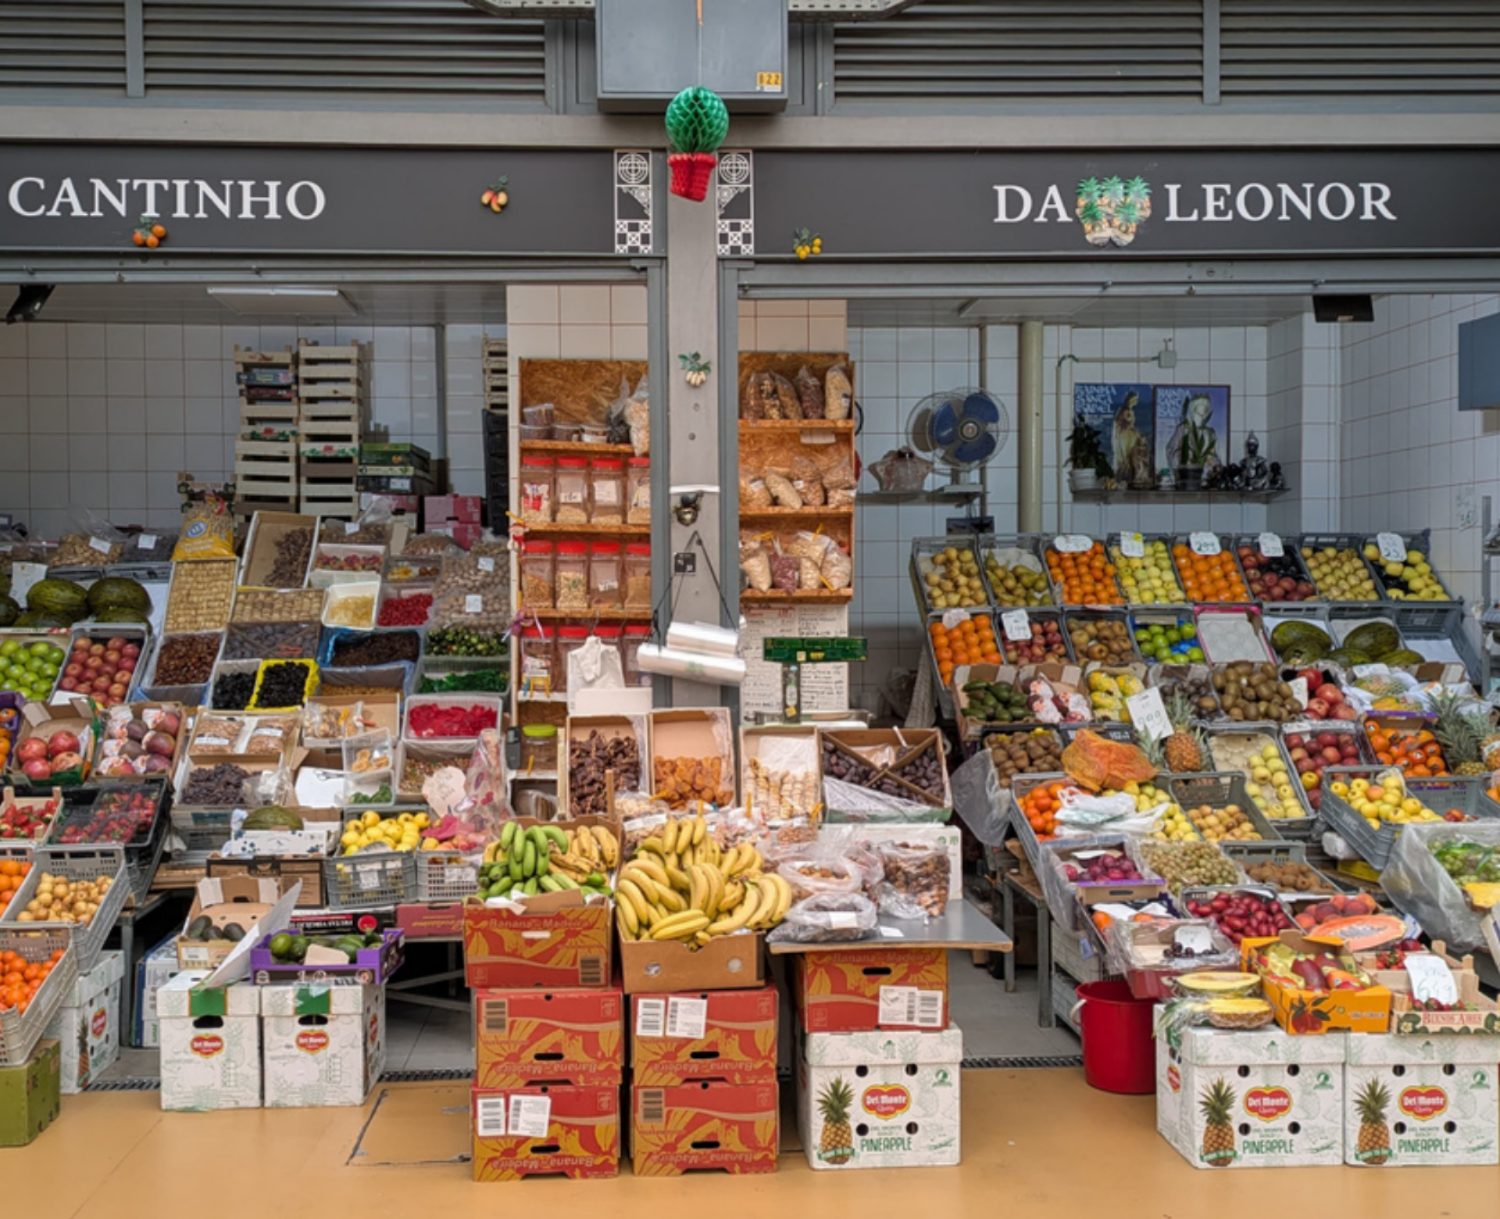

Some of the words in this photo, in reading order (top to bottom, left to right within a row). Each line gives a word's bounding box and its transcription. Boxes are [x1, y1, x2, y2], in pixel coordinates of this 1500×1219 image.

[7, 176, 327, 220] CANTINHO
[993, 184, 1073, 223] DA
[1165, 182, 1397, 222] LEONOR
[489, 918, 532, 928] Banana
[542, 918, 589, 928] Madeira
[496, 1064, 542, 1075] Madeira
[553, 1062, 597, 1073] Banana
[866, 1095, 879, 1105] Del
[880, 1094, 907, 1104] Monte
[1247, 1097, 1261, 1107] Del
[1262, 1096, 1288, 1106] Monte
[1403, 1096, 1416, 1106] Del
[1417, 1096, 1445, 1106] Monte
[860, 1137, 912, 1152] PINEAPPLE
[1242, 1139, 1294, 1154] PINEAPPLE
[1397, 1138, 1450, 1153] PINEAPPLE
[492, 1159, 538, 1170] Madeira
[550, 1156, 594, 1167] Banana
